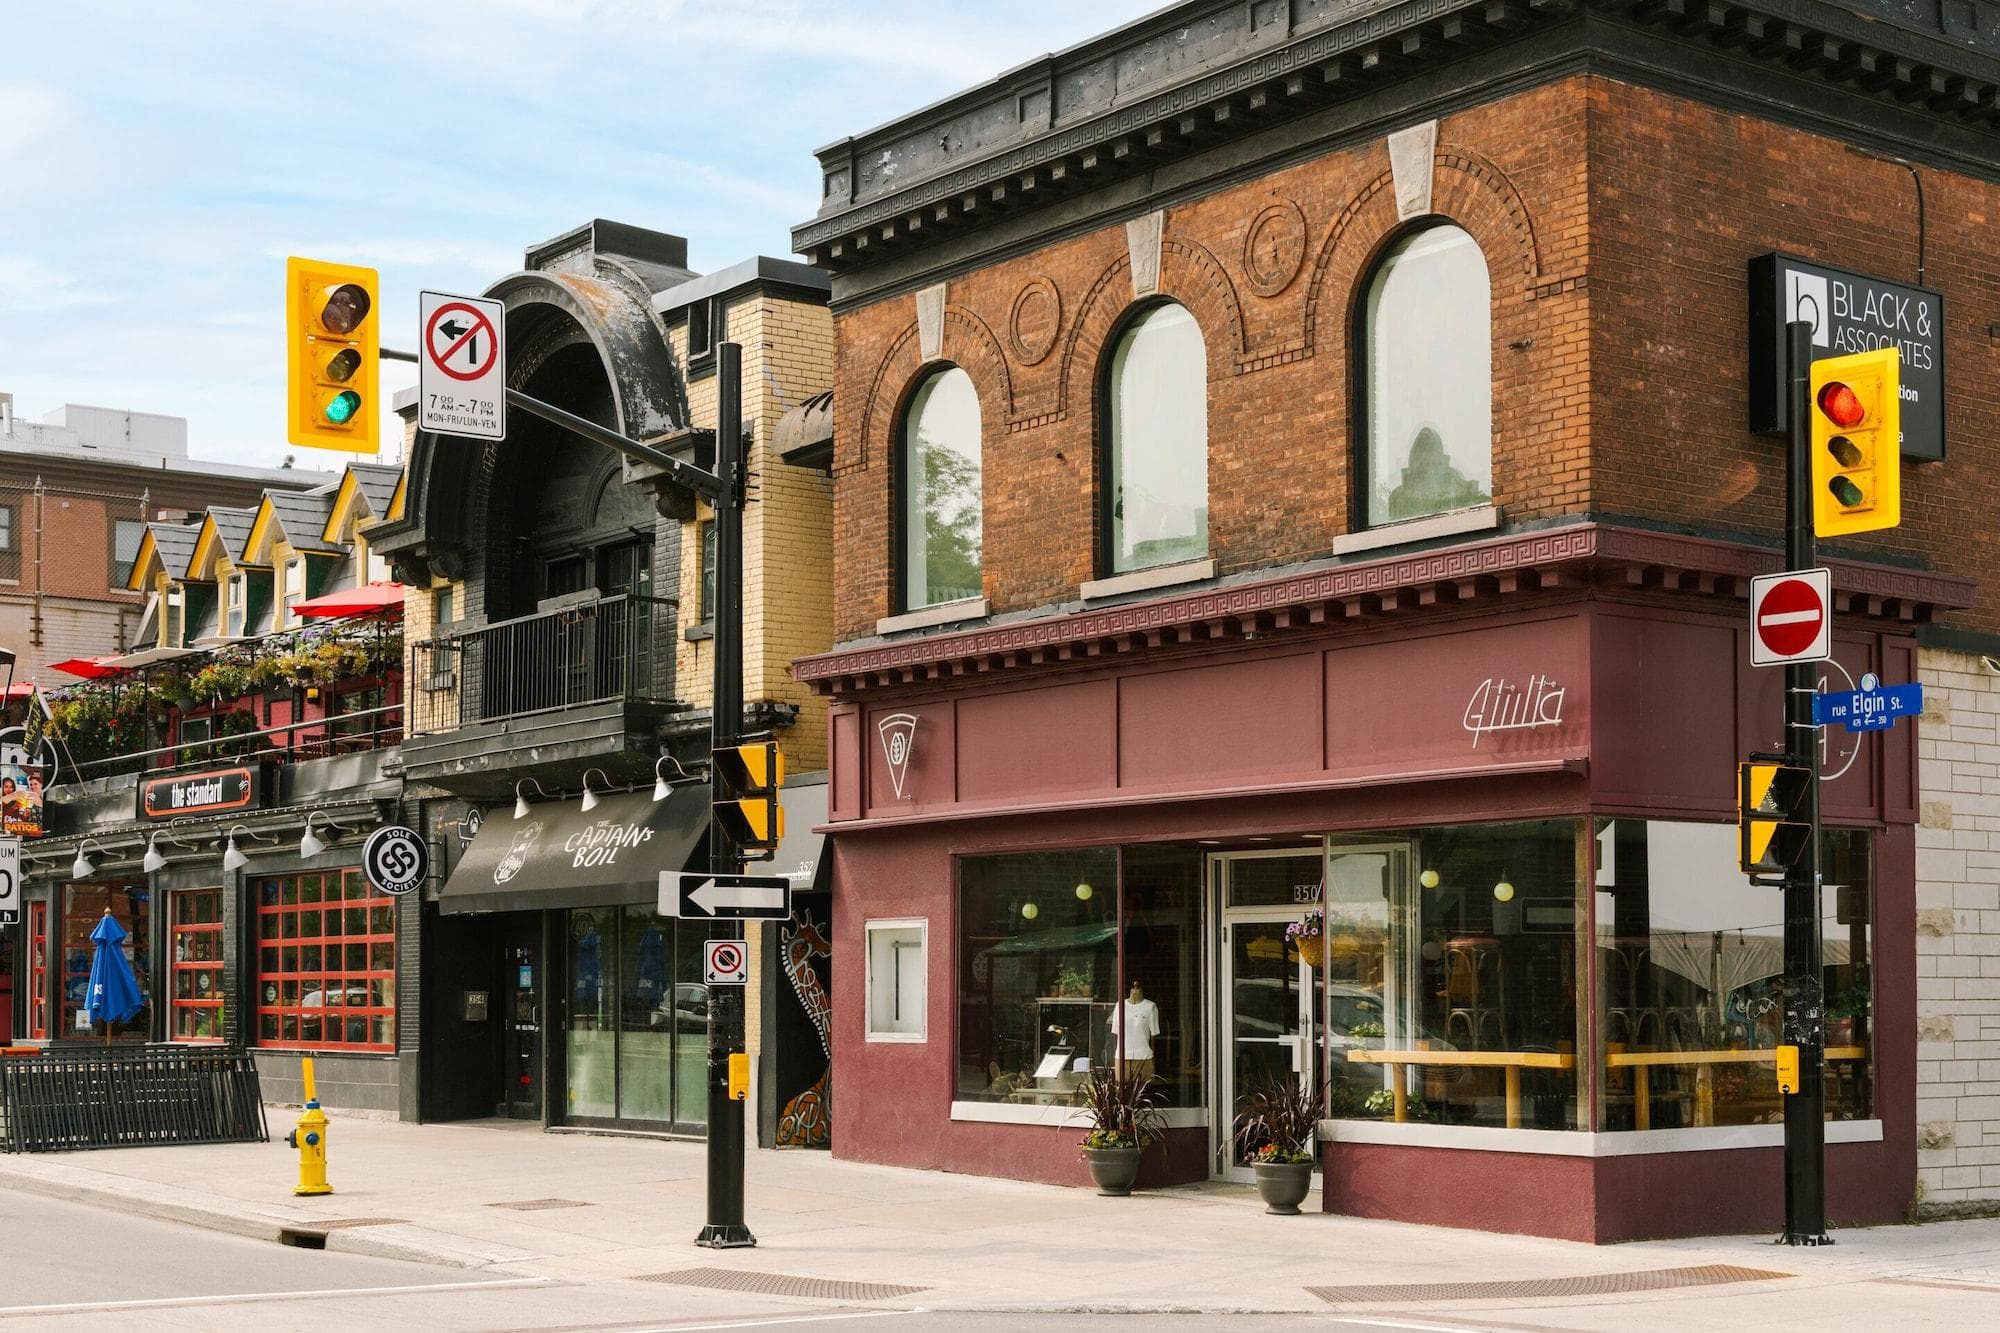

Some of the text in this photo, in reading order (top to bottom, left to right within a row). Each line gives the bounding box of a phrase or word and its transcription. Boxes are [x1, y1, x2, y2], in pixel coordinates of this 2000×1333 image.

[1832, 281, 1932, 338] BLACK &
[430, 394, 438, 409] 7
[440, 403, 454, 411] AM
[470, 399, 478, 414] 7
[1832, 691, 1904, 718] rue Elgin St.
[171, 776, 223, 808] the standard
[5, 823, 38, 832] PATIOS
[386, 830, 411, 840] SOLE
[572, 846, 618, 868] BOIL
[381, 876, 419, 891] SOCIETY
[1295, 886, 1318, 900] 350
